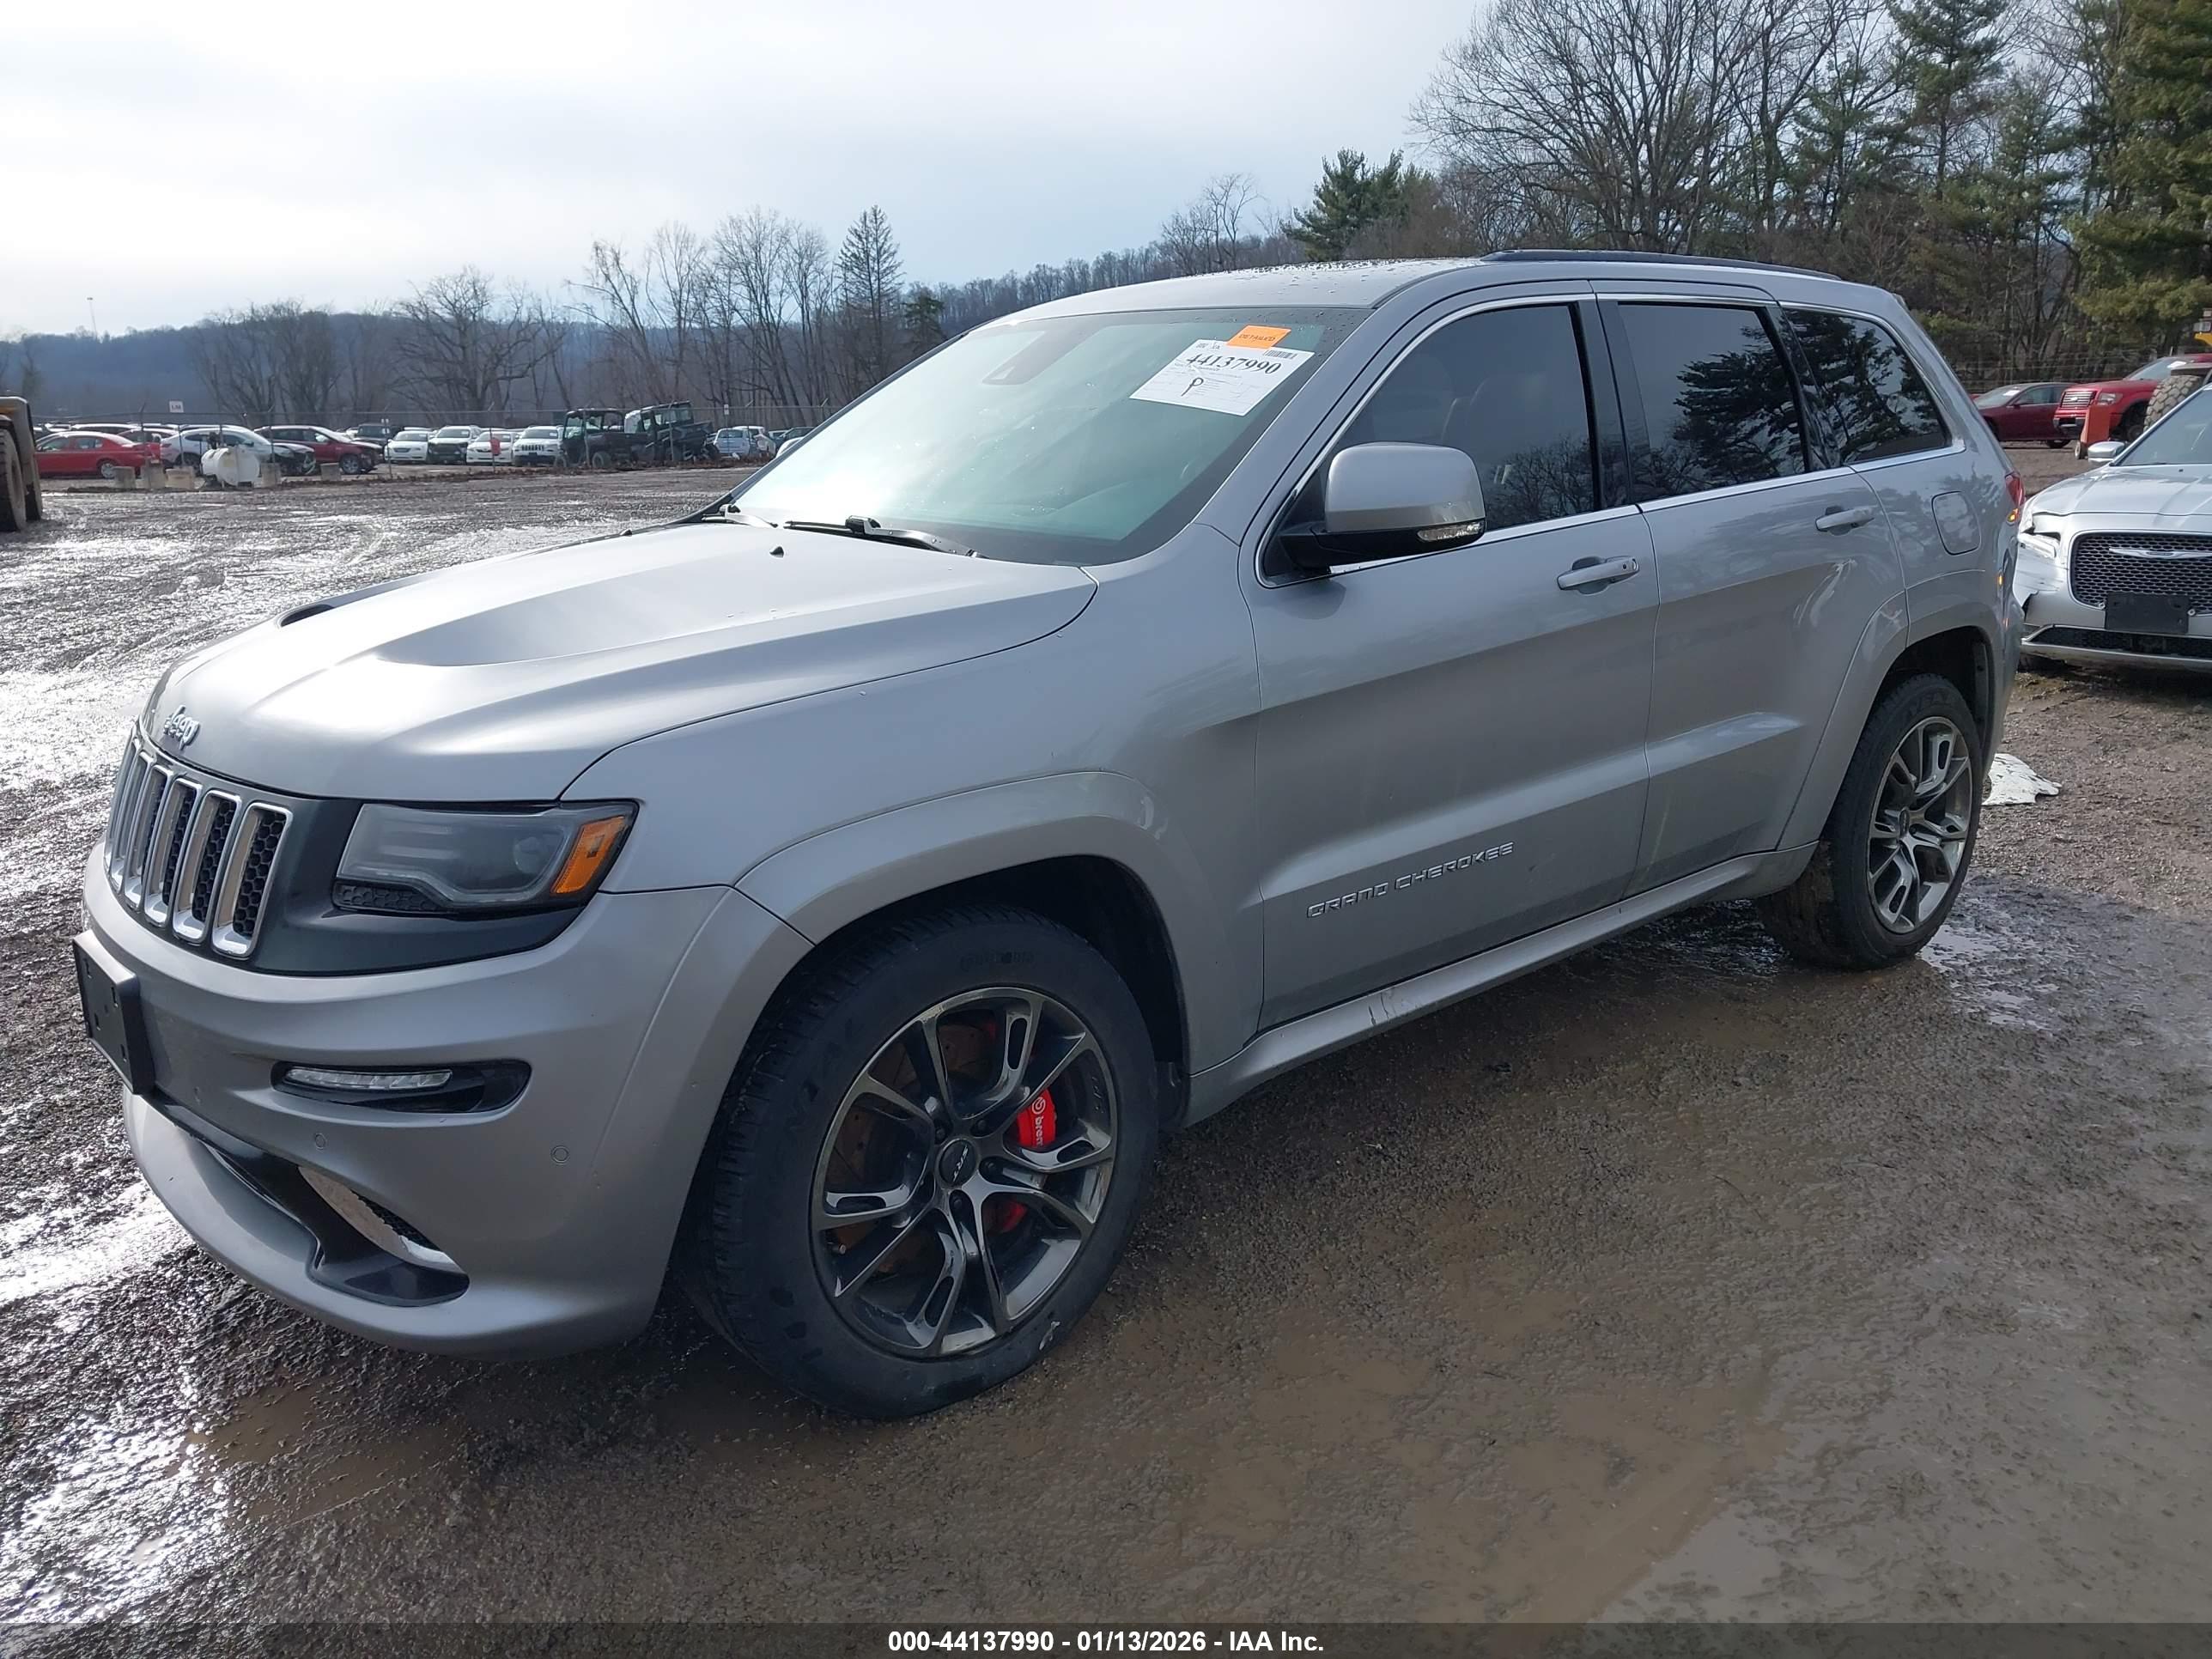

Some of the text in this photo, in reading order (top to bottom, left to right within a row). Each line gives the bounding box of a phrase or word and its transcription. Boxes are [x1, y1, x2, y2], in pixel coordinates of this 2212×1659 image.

[1186, 354, 1281, 374] 44137990
[1307, 842, 1514, 918] GRAND CHEROKEE
